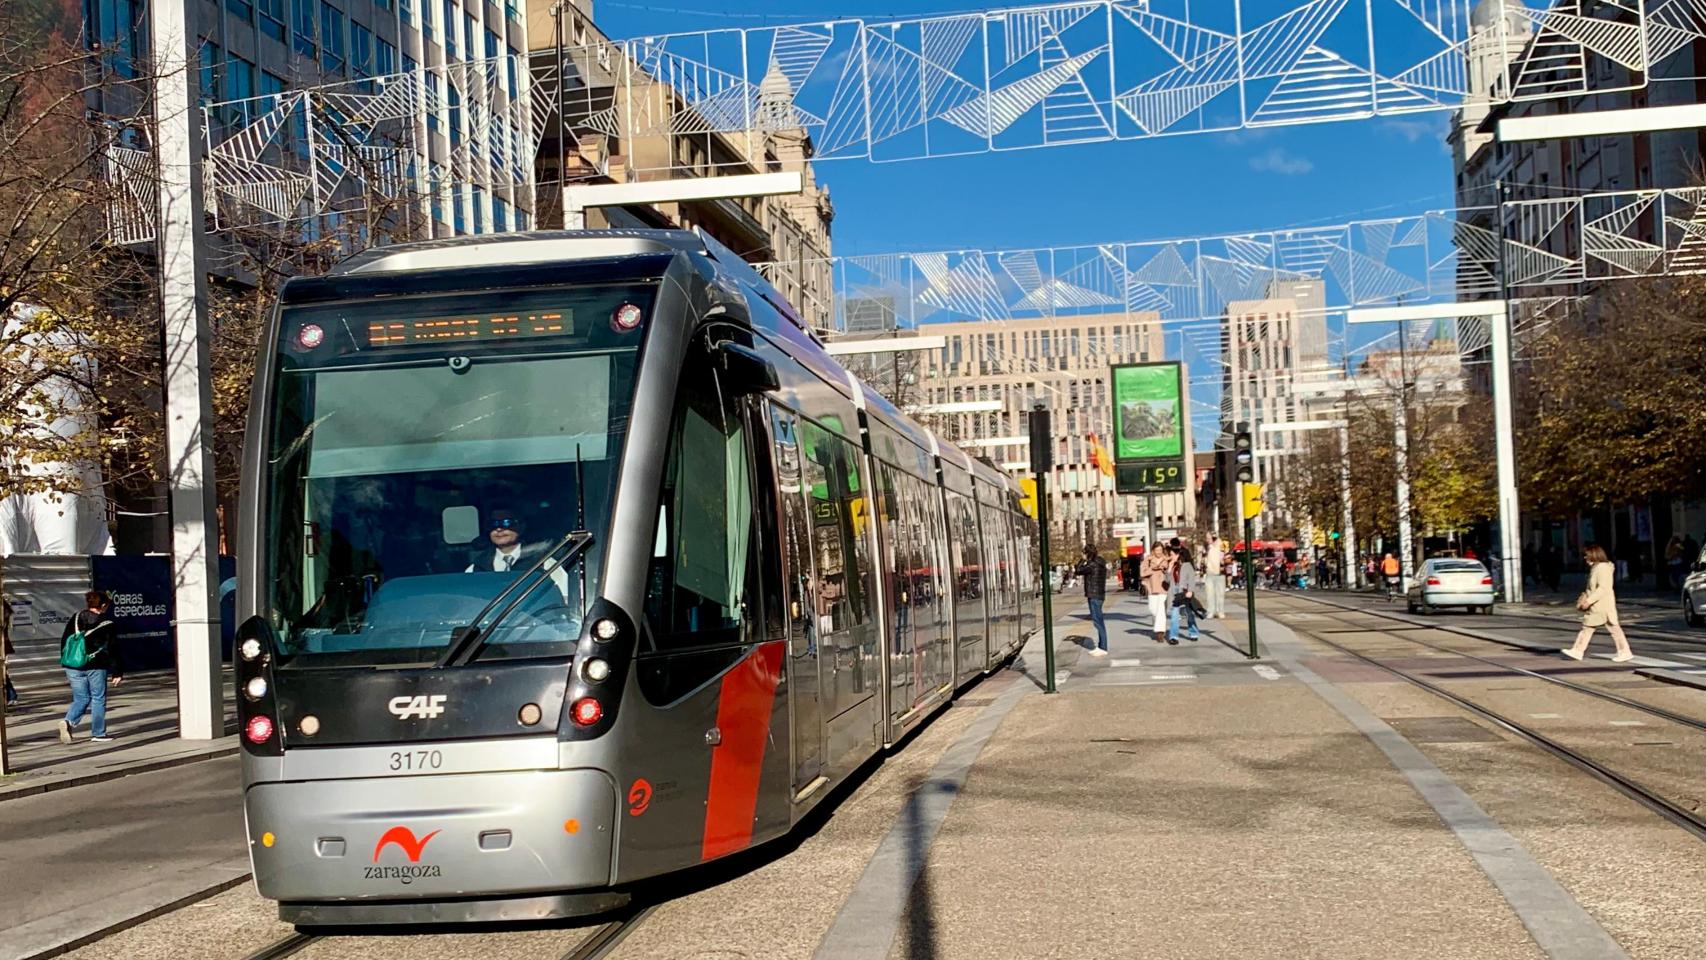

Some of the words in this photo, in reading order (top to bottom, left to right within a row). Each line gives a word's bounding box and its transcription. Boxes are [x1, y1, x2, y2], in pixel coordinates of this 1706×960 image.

[388, 694, 448, 720] CAF
[389, 750, 443, 771] 3170
[363, 864, 442, 885] zaragoza
